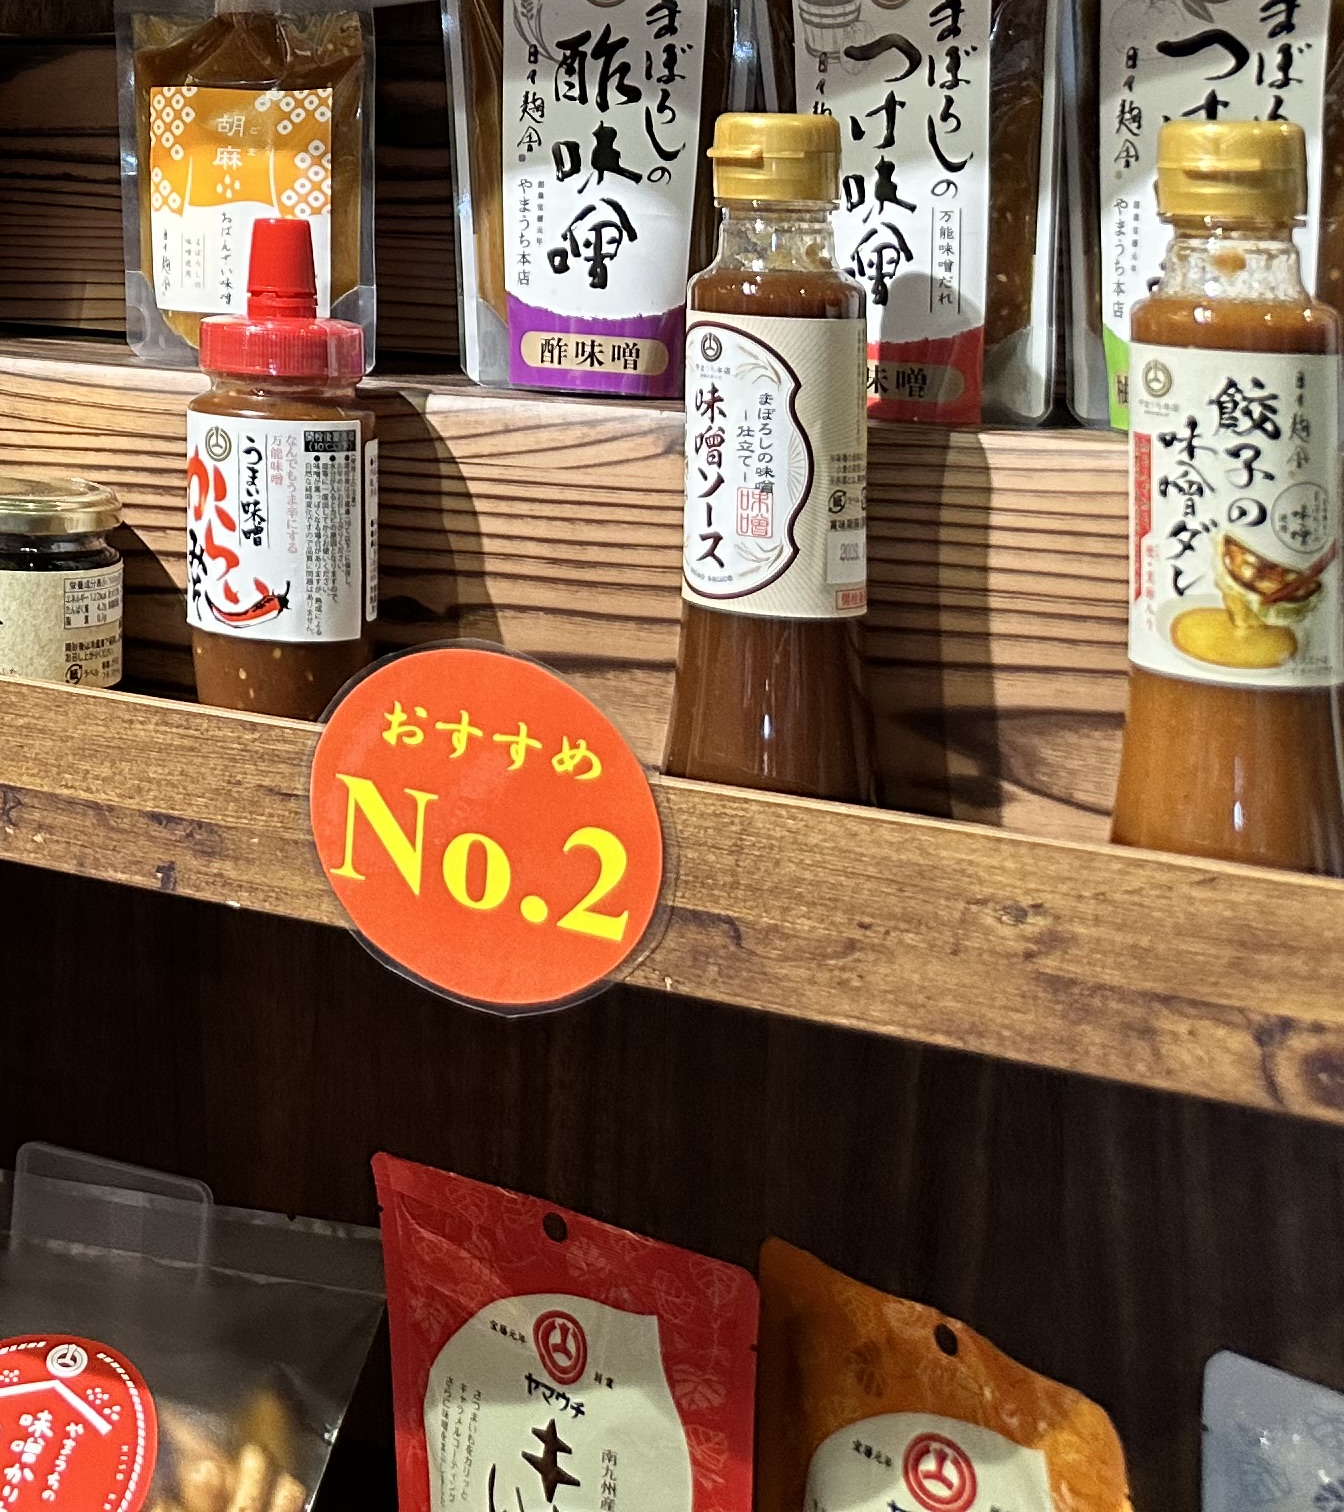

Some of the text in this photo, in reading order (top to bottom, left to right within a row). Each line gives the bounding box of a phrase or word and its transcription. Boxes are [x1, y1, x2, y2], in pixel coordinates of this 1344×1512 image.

[212, 114, 246, 171] 胡麻
[517, 178, 533, 287] やまうち本店
[936, 209, 956, 306] 万能味噌だれ
[1112, 198, 1129, 320] やまうち本店
[539, 335, 643, 373] 酢味噌
[241, 435, 267, 547] うまい味噌
[270, 434, 285, 487] 万能味噌
[694, 382, 728, 569] 味噌ソース
[736, 425, 756, 468] 仕立て
[755, 392, 776, 496] まぼろしの味噌
[1206, 375, 1282, 529] 餃子の
[284, 434, 299, 555] なんでもうま辛にする
[737, 490, 774, 538] 味噌
[382, 701, 602, 781] おすすめ
[330, 773, 629, 942] No.2
[524, 1371, 586, 1420] ヤマウチ
[42, 1422, 85, 1502] やまうちの
